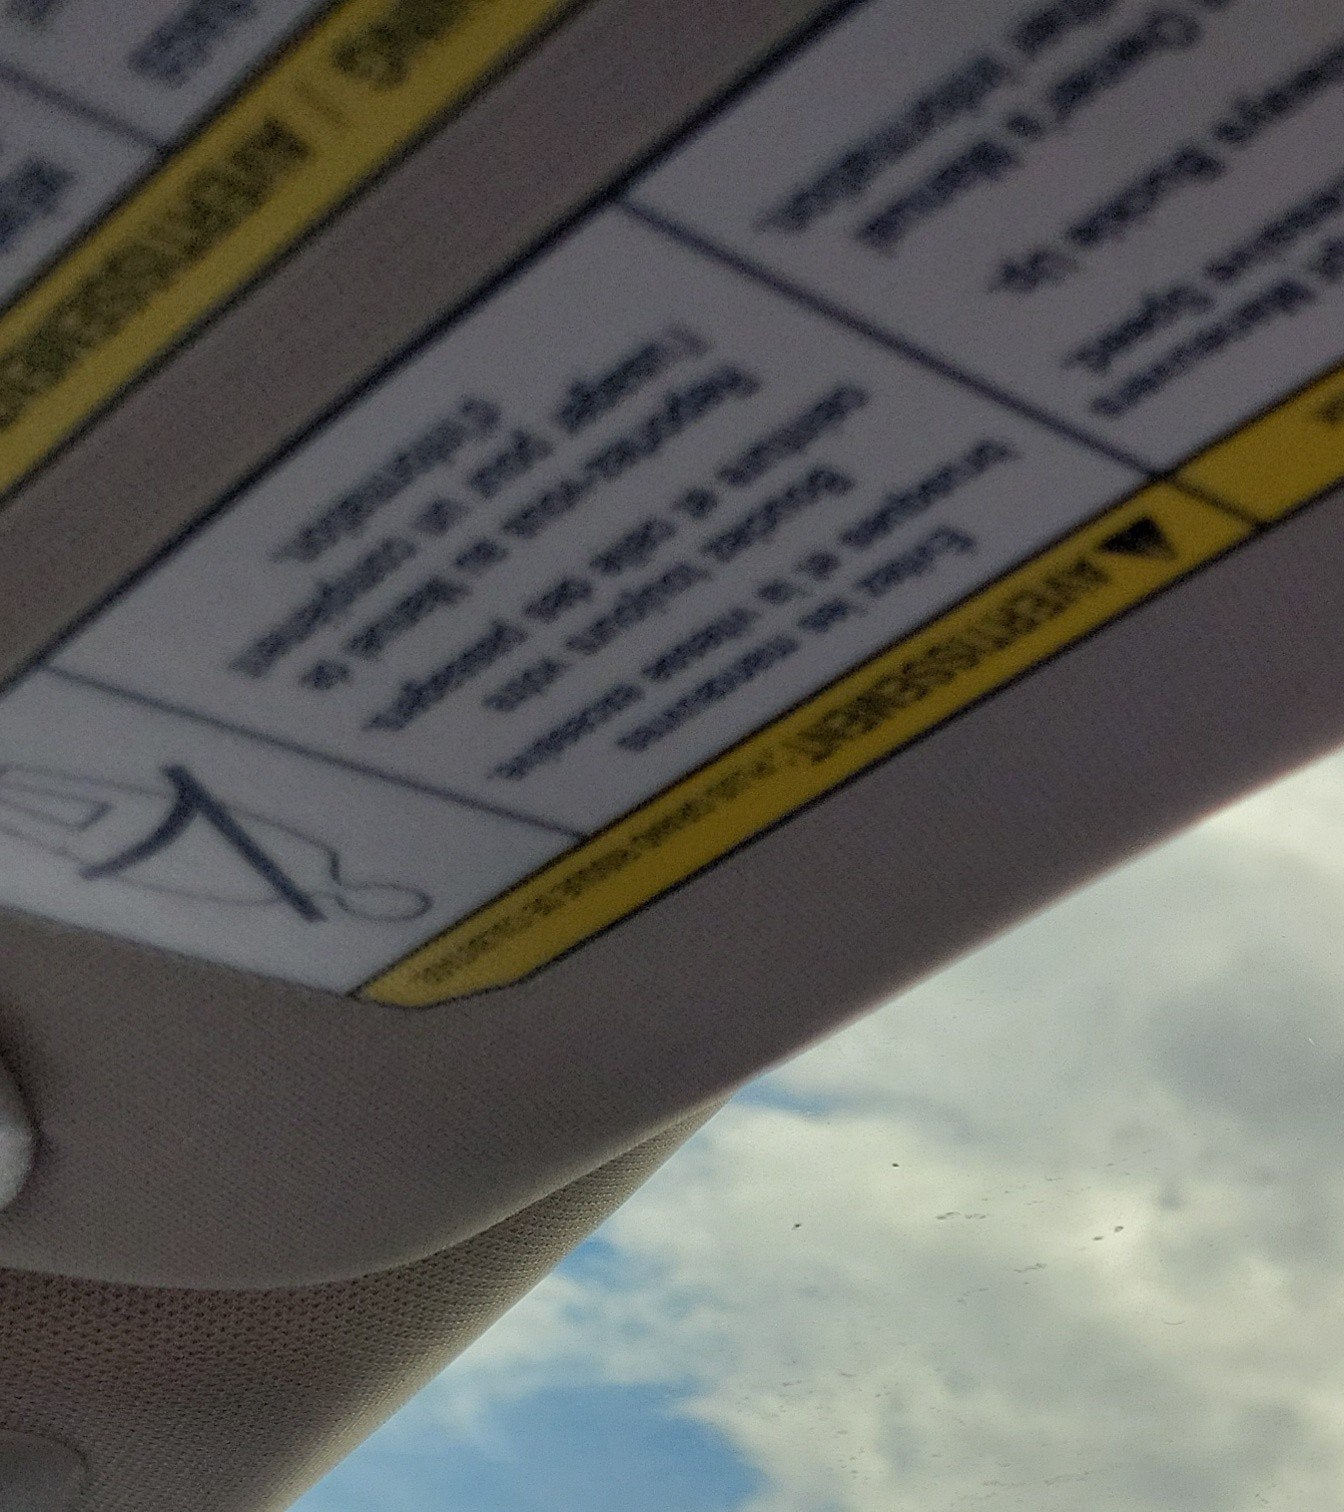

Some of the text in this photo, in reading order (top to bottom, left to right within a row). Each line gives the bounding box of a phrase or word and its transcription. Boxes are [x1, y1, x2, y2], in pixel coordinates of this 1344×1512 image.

[763, 52, 1019, 232] information.
[855, 7, 1202, 250] Owner's Manual
[1064, 143, 1225, 250] Buckle
[0, 117, 311, 432] AVERTISSEMEN
[992, 246, 1076, 293] Up.
[1070, 284, 1213, 373] Speed.
[1090, 276, 1317, 419] Maneuvers
[302, 365, 760, 690] Reportez-vous au Manuel de
[417, 499, 460, 534] un
[467, 429, 552, 499] pour
[369, 385, 867, 730] ceinture et celle des passagers.
[485, 465, 854, 711] Bouclez toujours votre
[493, 439, 1012, 780] brusques et la vitesse excessive.
[797, 598, 855, 633] les
